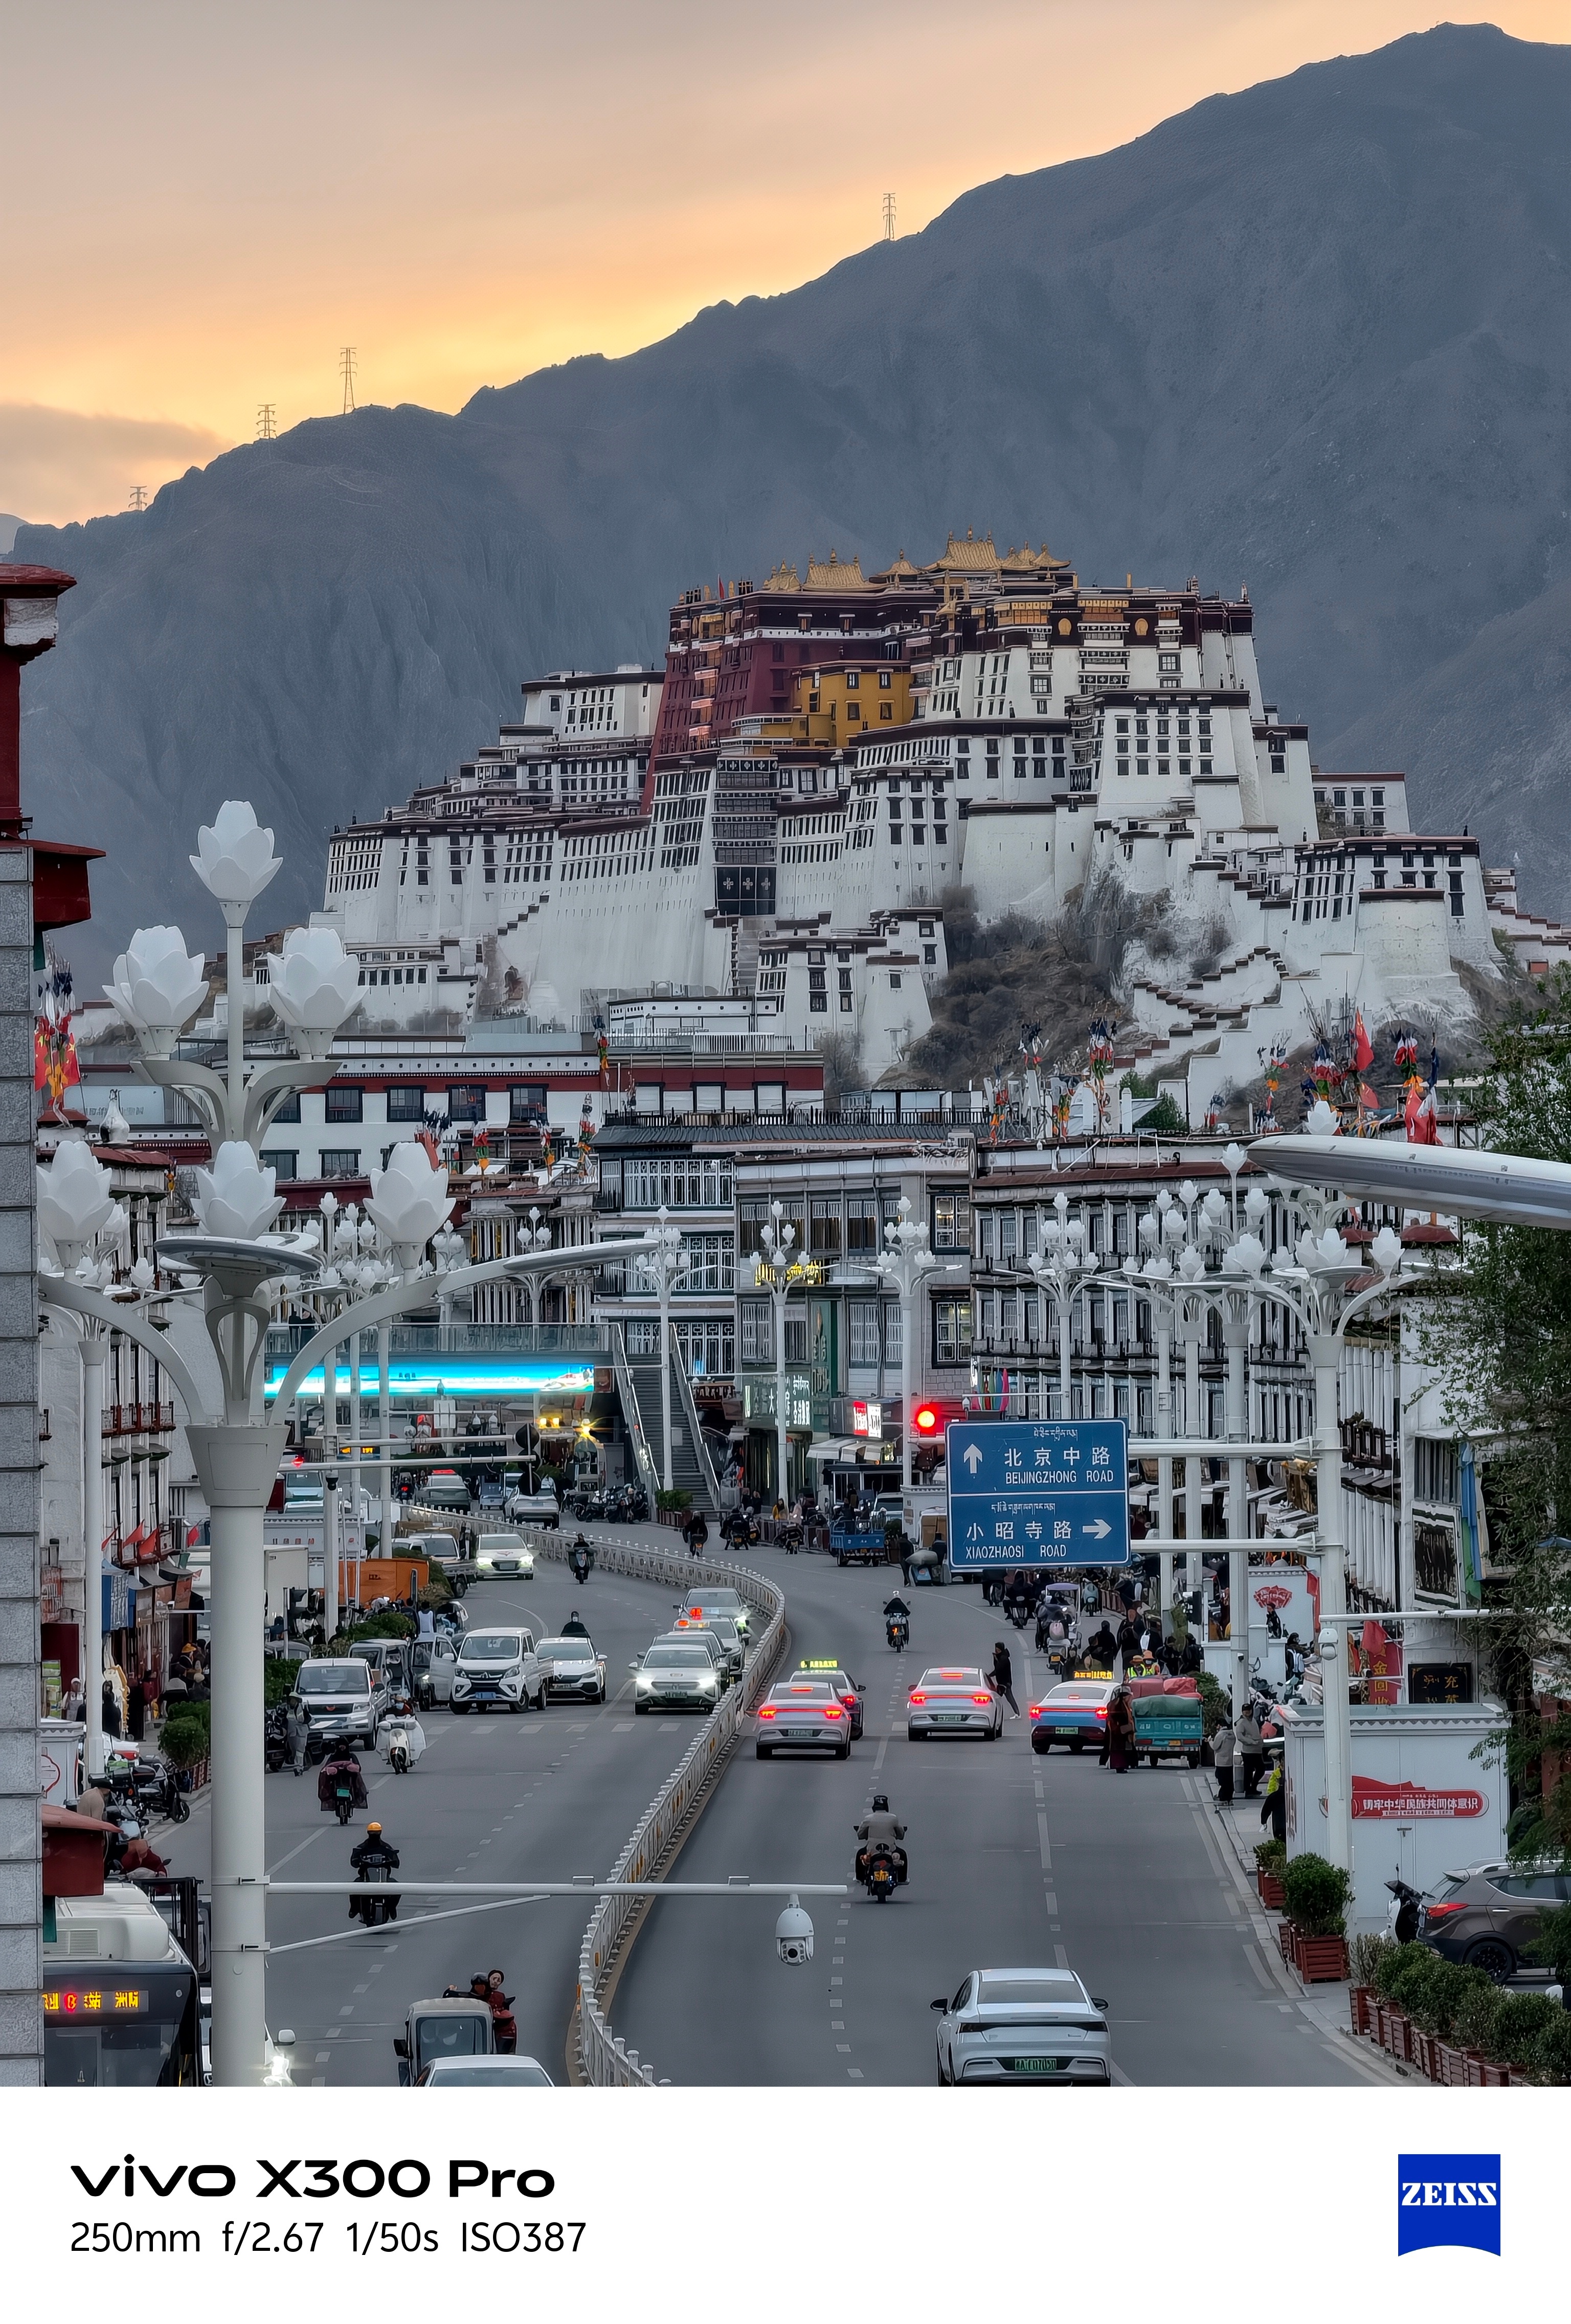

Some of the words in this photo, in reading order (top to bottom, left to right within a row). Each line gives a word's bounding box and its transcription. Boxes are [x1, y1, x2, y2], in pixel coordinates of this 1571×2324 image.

[1004, 1446, 1110, 1467] 北京中路
[1005, 1470, 1077, 1484] BEIJINGZHONG
[1086, 1470, 1114, 1483] ROAD
[967, 1521, 1072, 1541] 小昭寺路
[966, 1545, 1024, 1560] XIAOZHAOSI
[1040, 1545, 1067, 1558] ROAD
